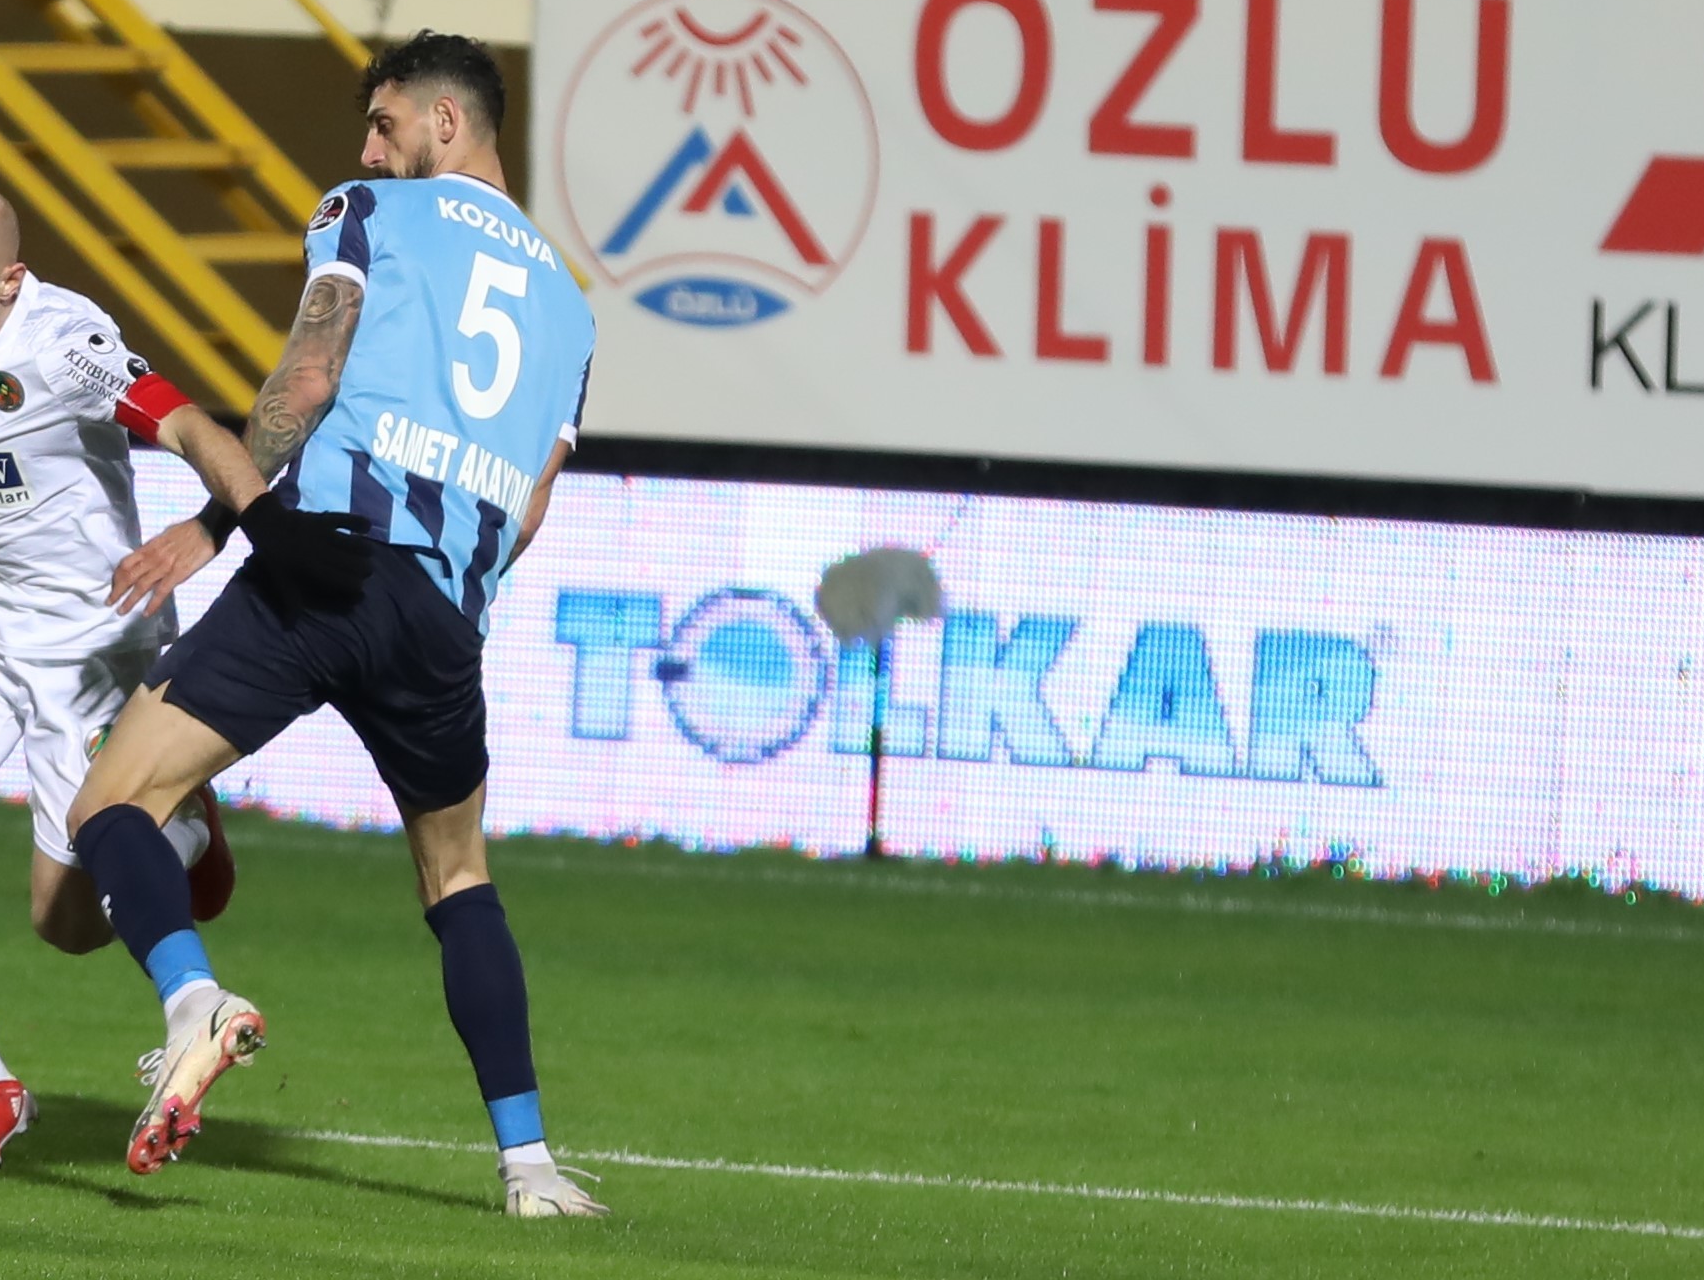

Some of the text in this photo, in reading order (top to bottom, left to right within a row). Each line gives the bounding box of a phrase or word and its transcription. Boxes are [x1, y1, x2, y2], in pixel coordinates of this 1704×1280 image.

[437, 196, 558, 272] KOZUVA
[904, 184, 1501, 384] KLİMA
[452, 251, 528, 419] 5
[373, 411, 460, 482] SAMET
[555, 584, 1385, 788] TOLKAR
